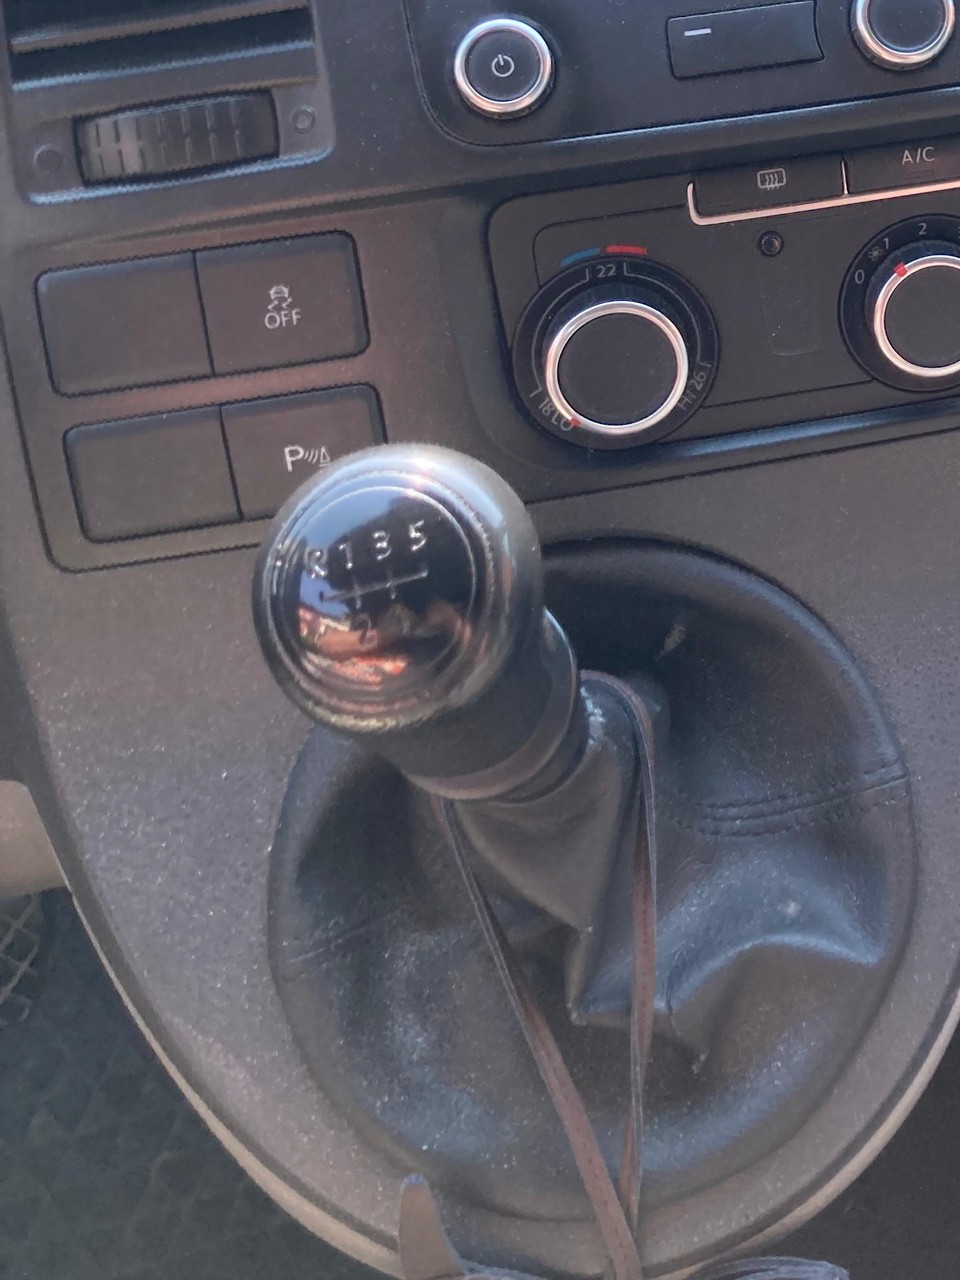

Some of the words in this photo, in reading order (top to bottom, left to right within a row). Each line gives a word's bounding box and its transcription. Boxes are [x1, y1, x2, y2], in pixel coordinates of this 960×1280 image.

[901, 147, 935, 166] A/C
[917, 223, 927, 236] 2
[597, 263, 617, 278] 22
[264, 309, 301, 330] OFF
[304, 546, 328, 580] R
[338, 541, 354, 571] 1
[372, 529, 393, 561] 3
[408, 518, 429, 552] 5
